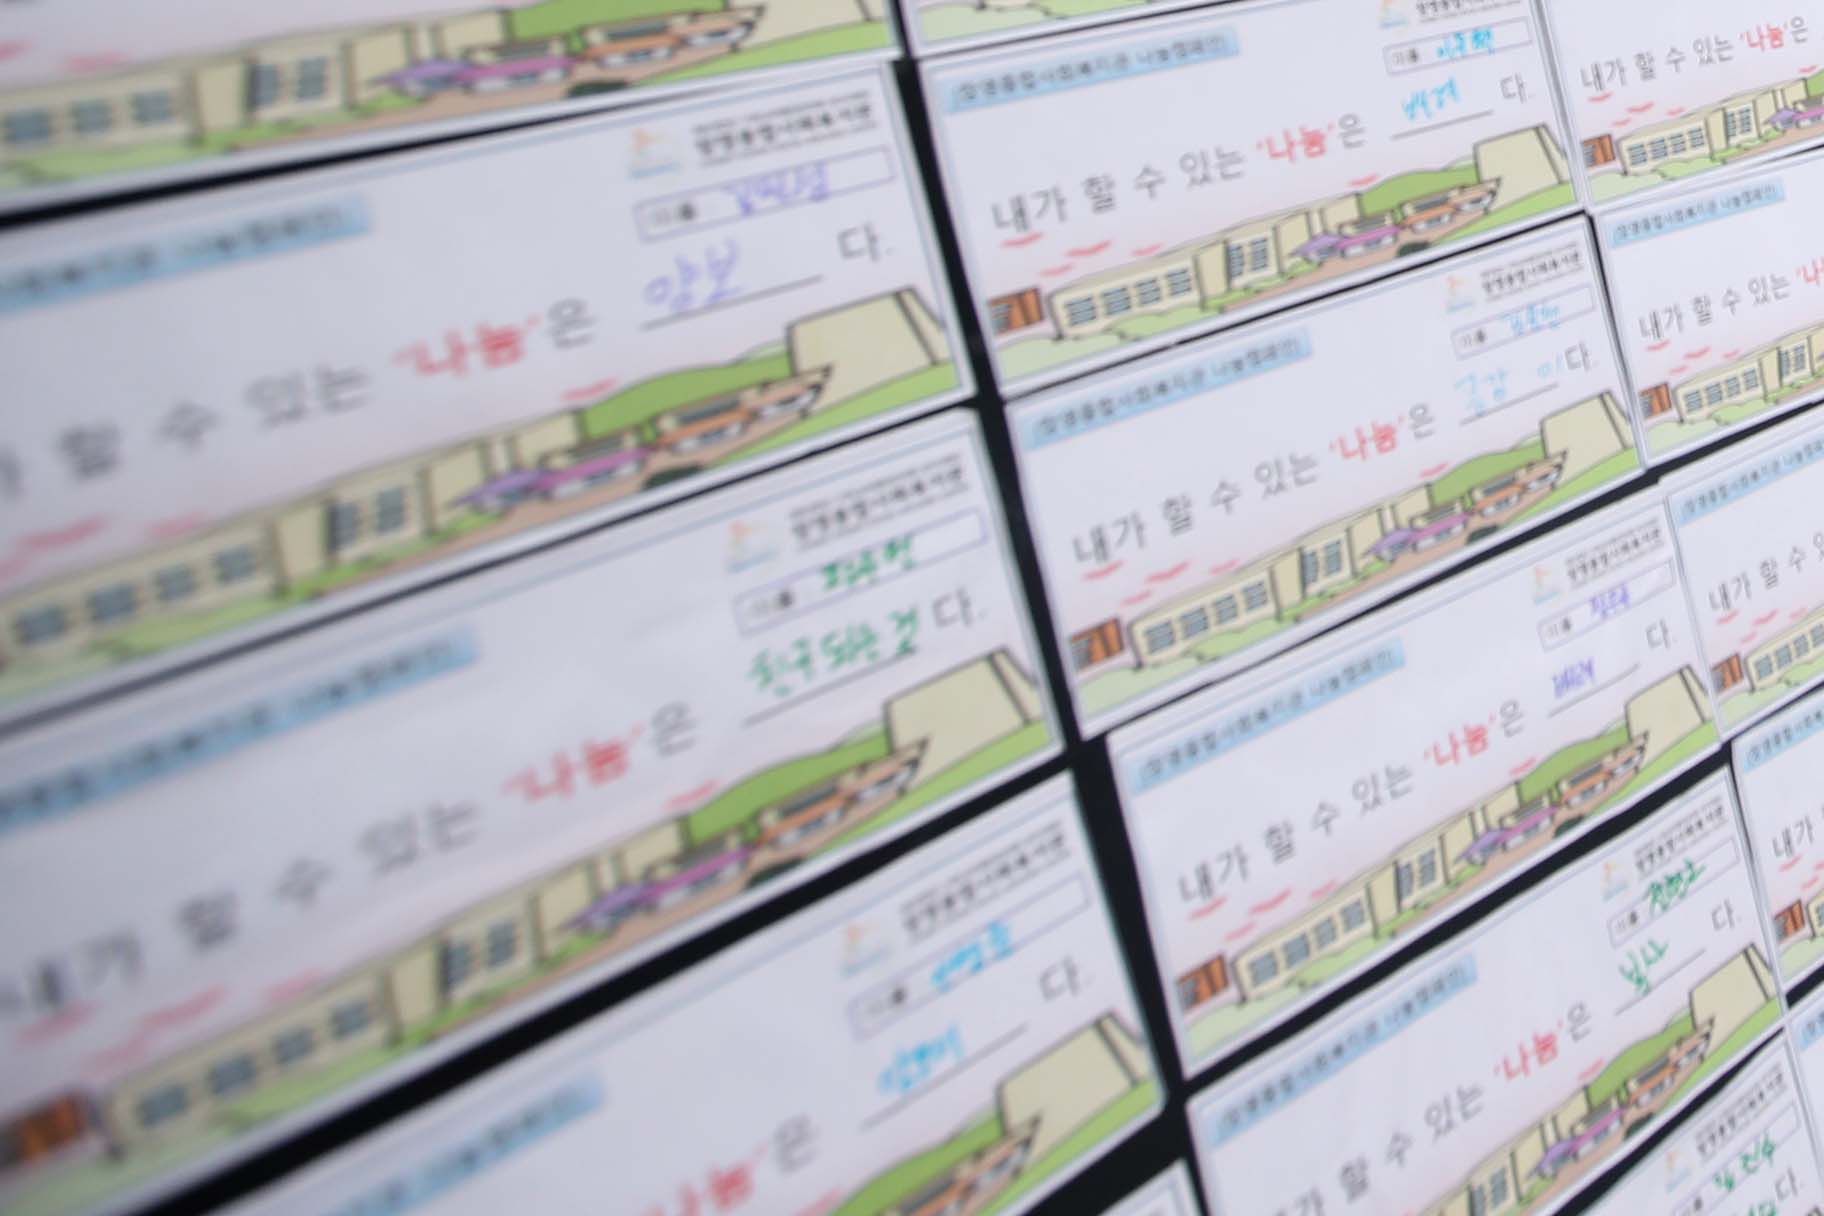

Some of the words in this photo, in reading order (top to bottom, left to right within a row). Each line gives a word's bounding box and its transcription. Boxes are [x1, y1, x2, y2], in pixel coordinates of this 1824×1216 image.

[1580, 59, 1625, 91] 내가
[1634, 52, 1656, 81] 할
[1666, 47, 1686, 73] 수
[1693, 36, 1734, 66] 있는
[1709, 573, 1751, 611] 내가
[1760, 559, 1778, 589] 할
[1789, 546, 1806, 573] 수
